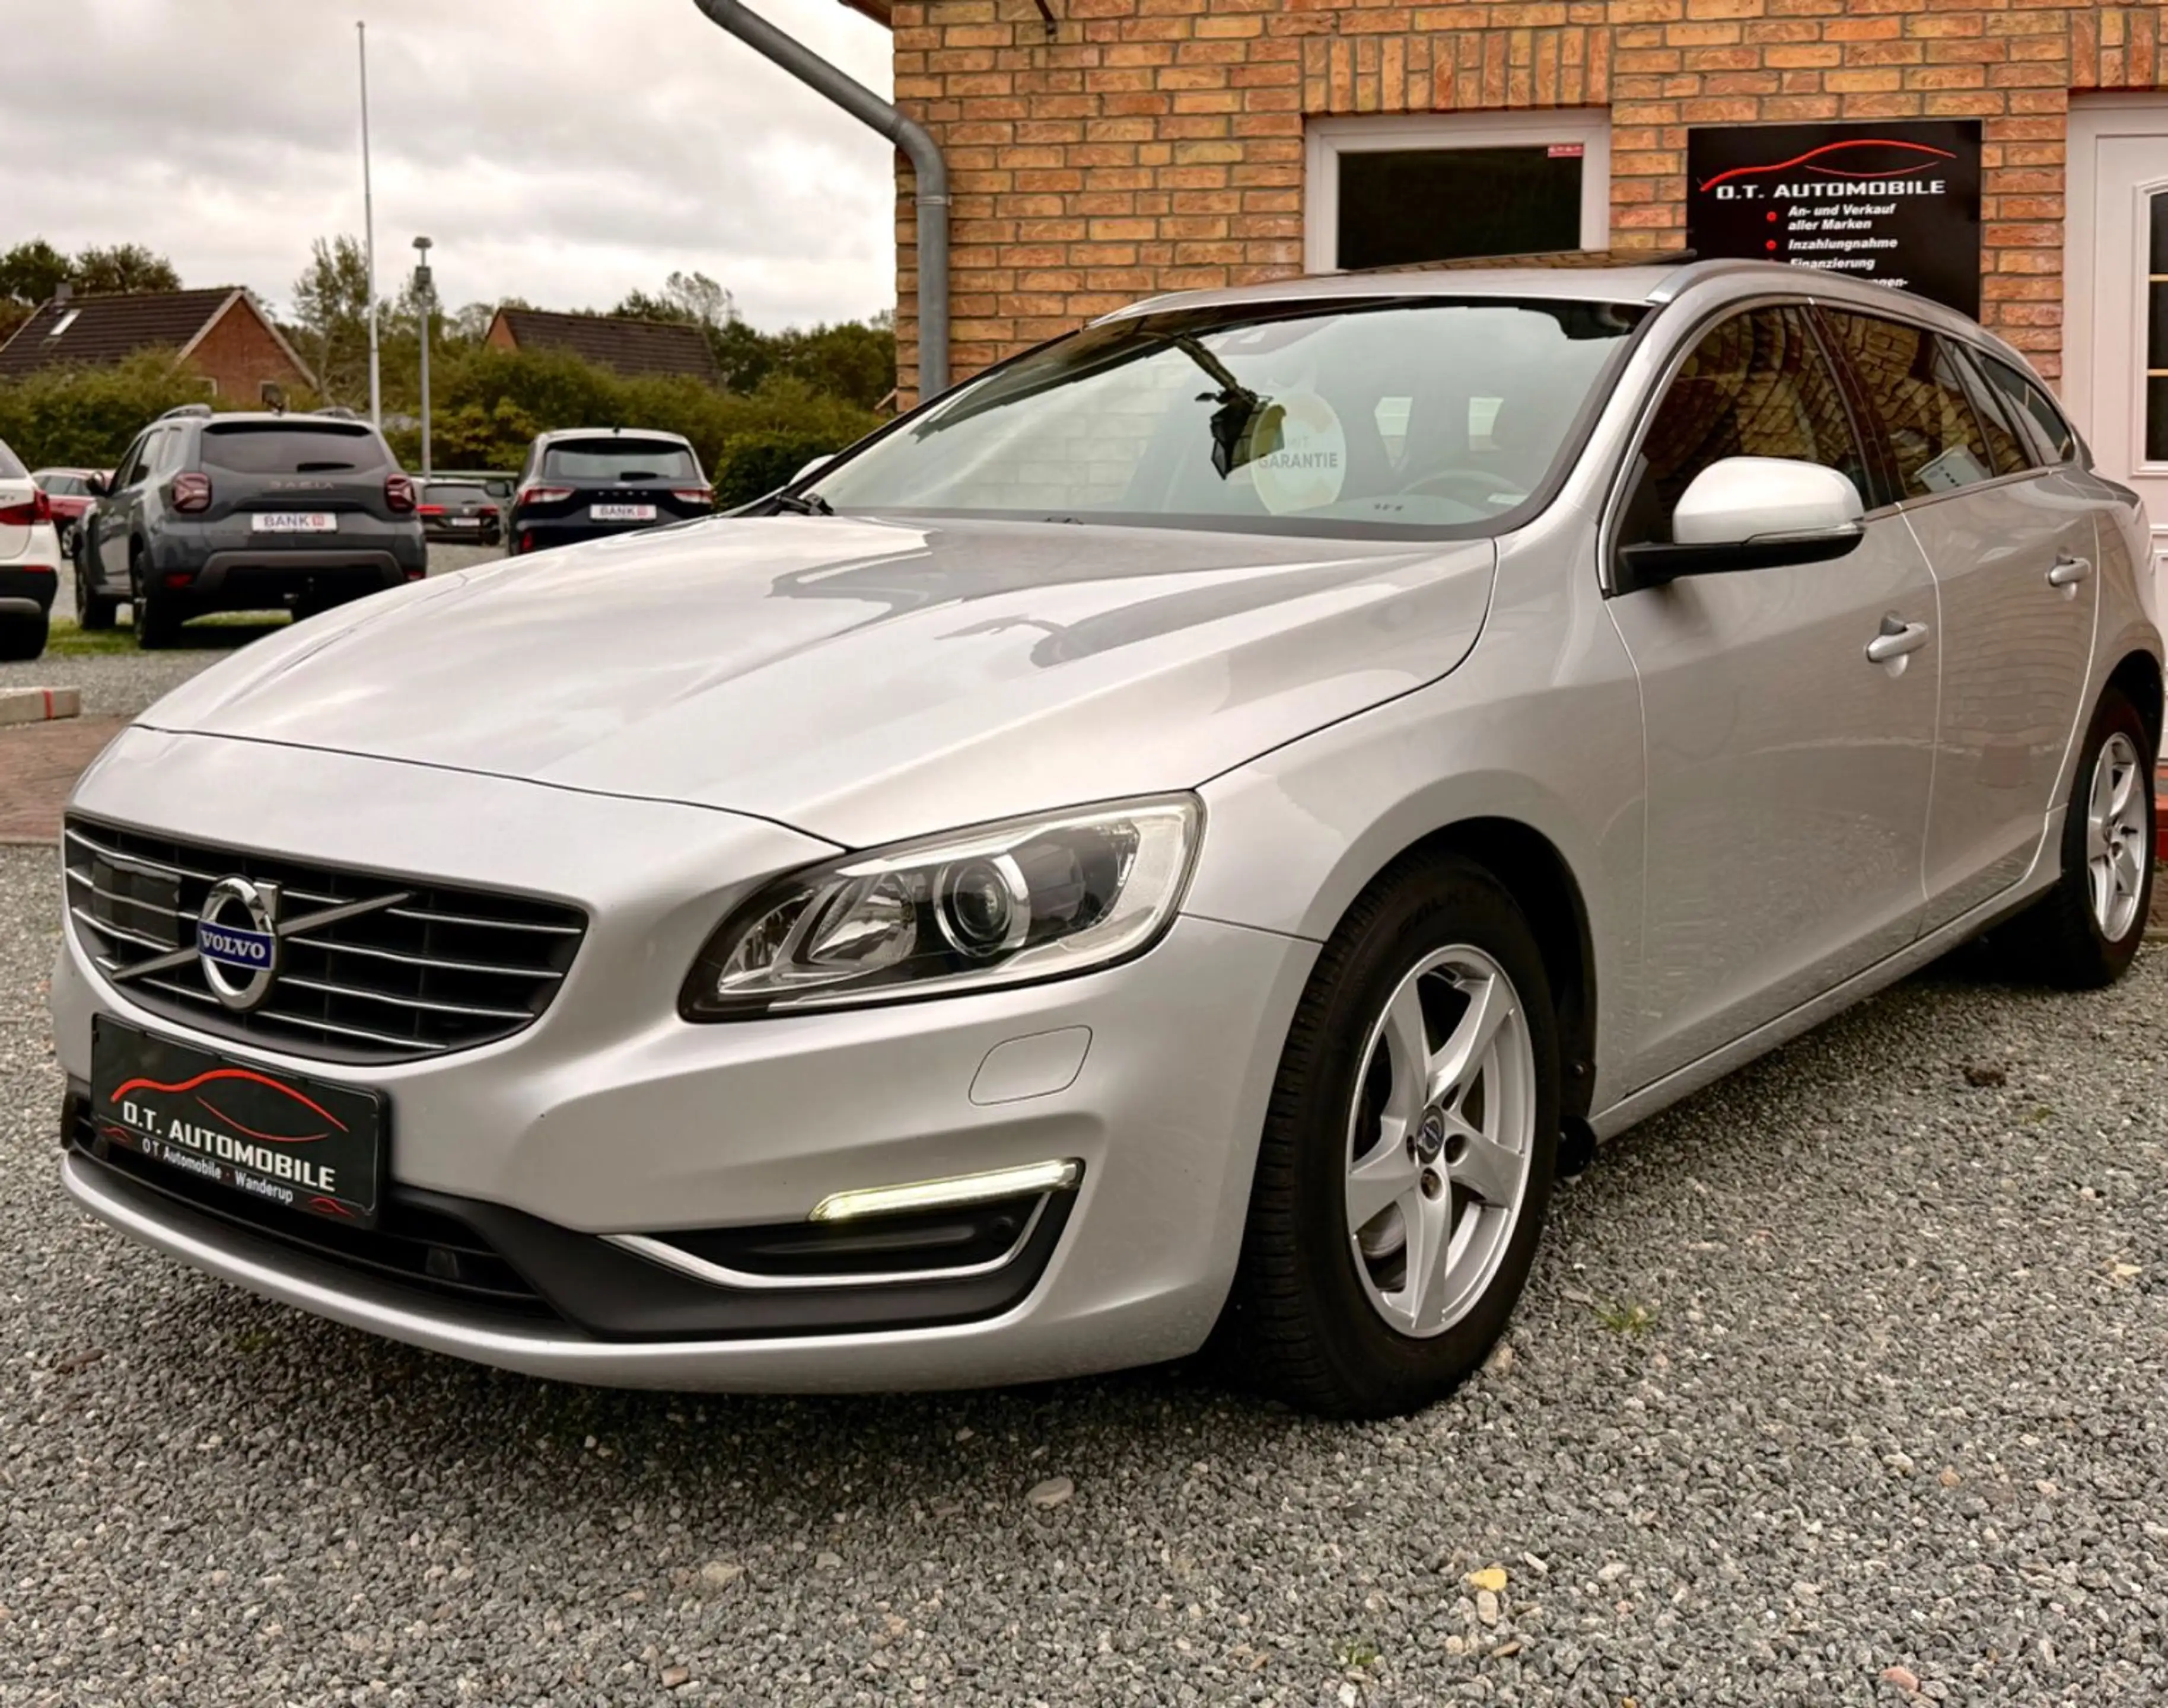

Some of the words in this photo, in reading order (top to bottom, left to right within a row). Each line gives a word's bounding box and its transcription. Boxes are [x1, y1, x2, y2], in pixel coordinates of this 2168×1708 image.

[1715, 185, 1765, 200] O.T.
[1772, 180, 1946, 199] AUTOMOBILE
[1787, 205, 1812, 218] An-
[1813, 204, 1840, 216] und
[1842, 202, 1898, 216] Verkauf
[1787, 219, 1820, 231] aller
[1820, 218, 1873, 230] Marken
[1787, 237, 1899, 252] Inzahlungnahme
[1258, 452, 1339, 469] GARANTIE
[200, 930, 266, 960] VOLVO
[123, 1100, 163, 1135] O.T.
[168, 1119, 336, 1193] AUTOMOBILE
[163, 1145, 222, 1180] Automobile
[234, 1170, 294, 1206] Wanderup
